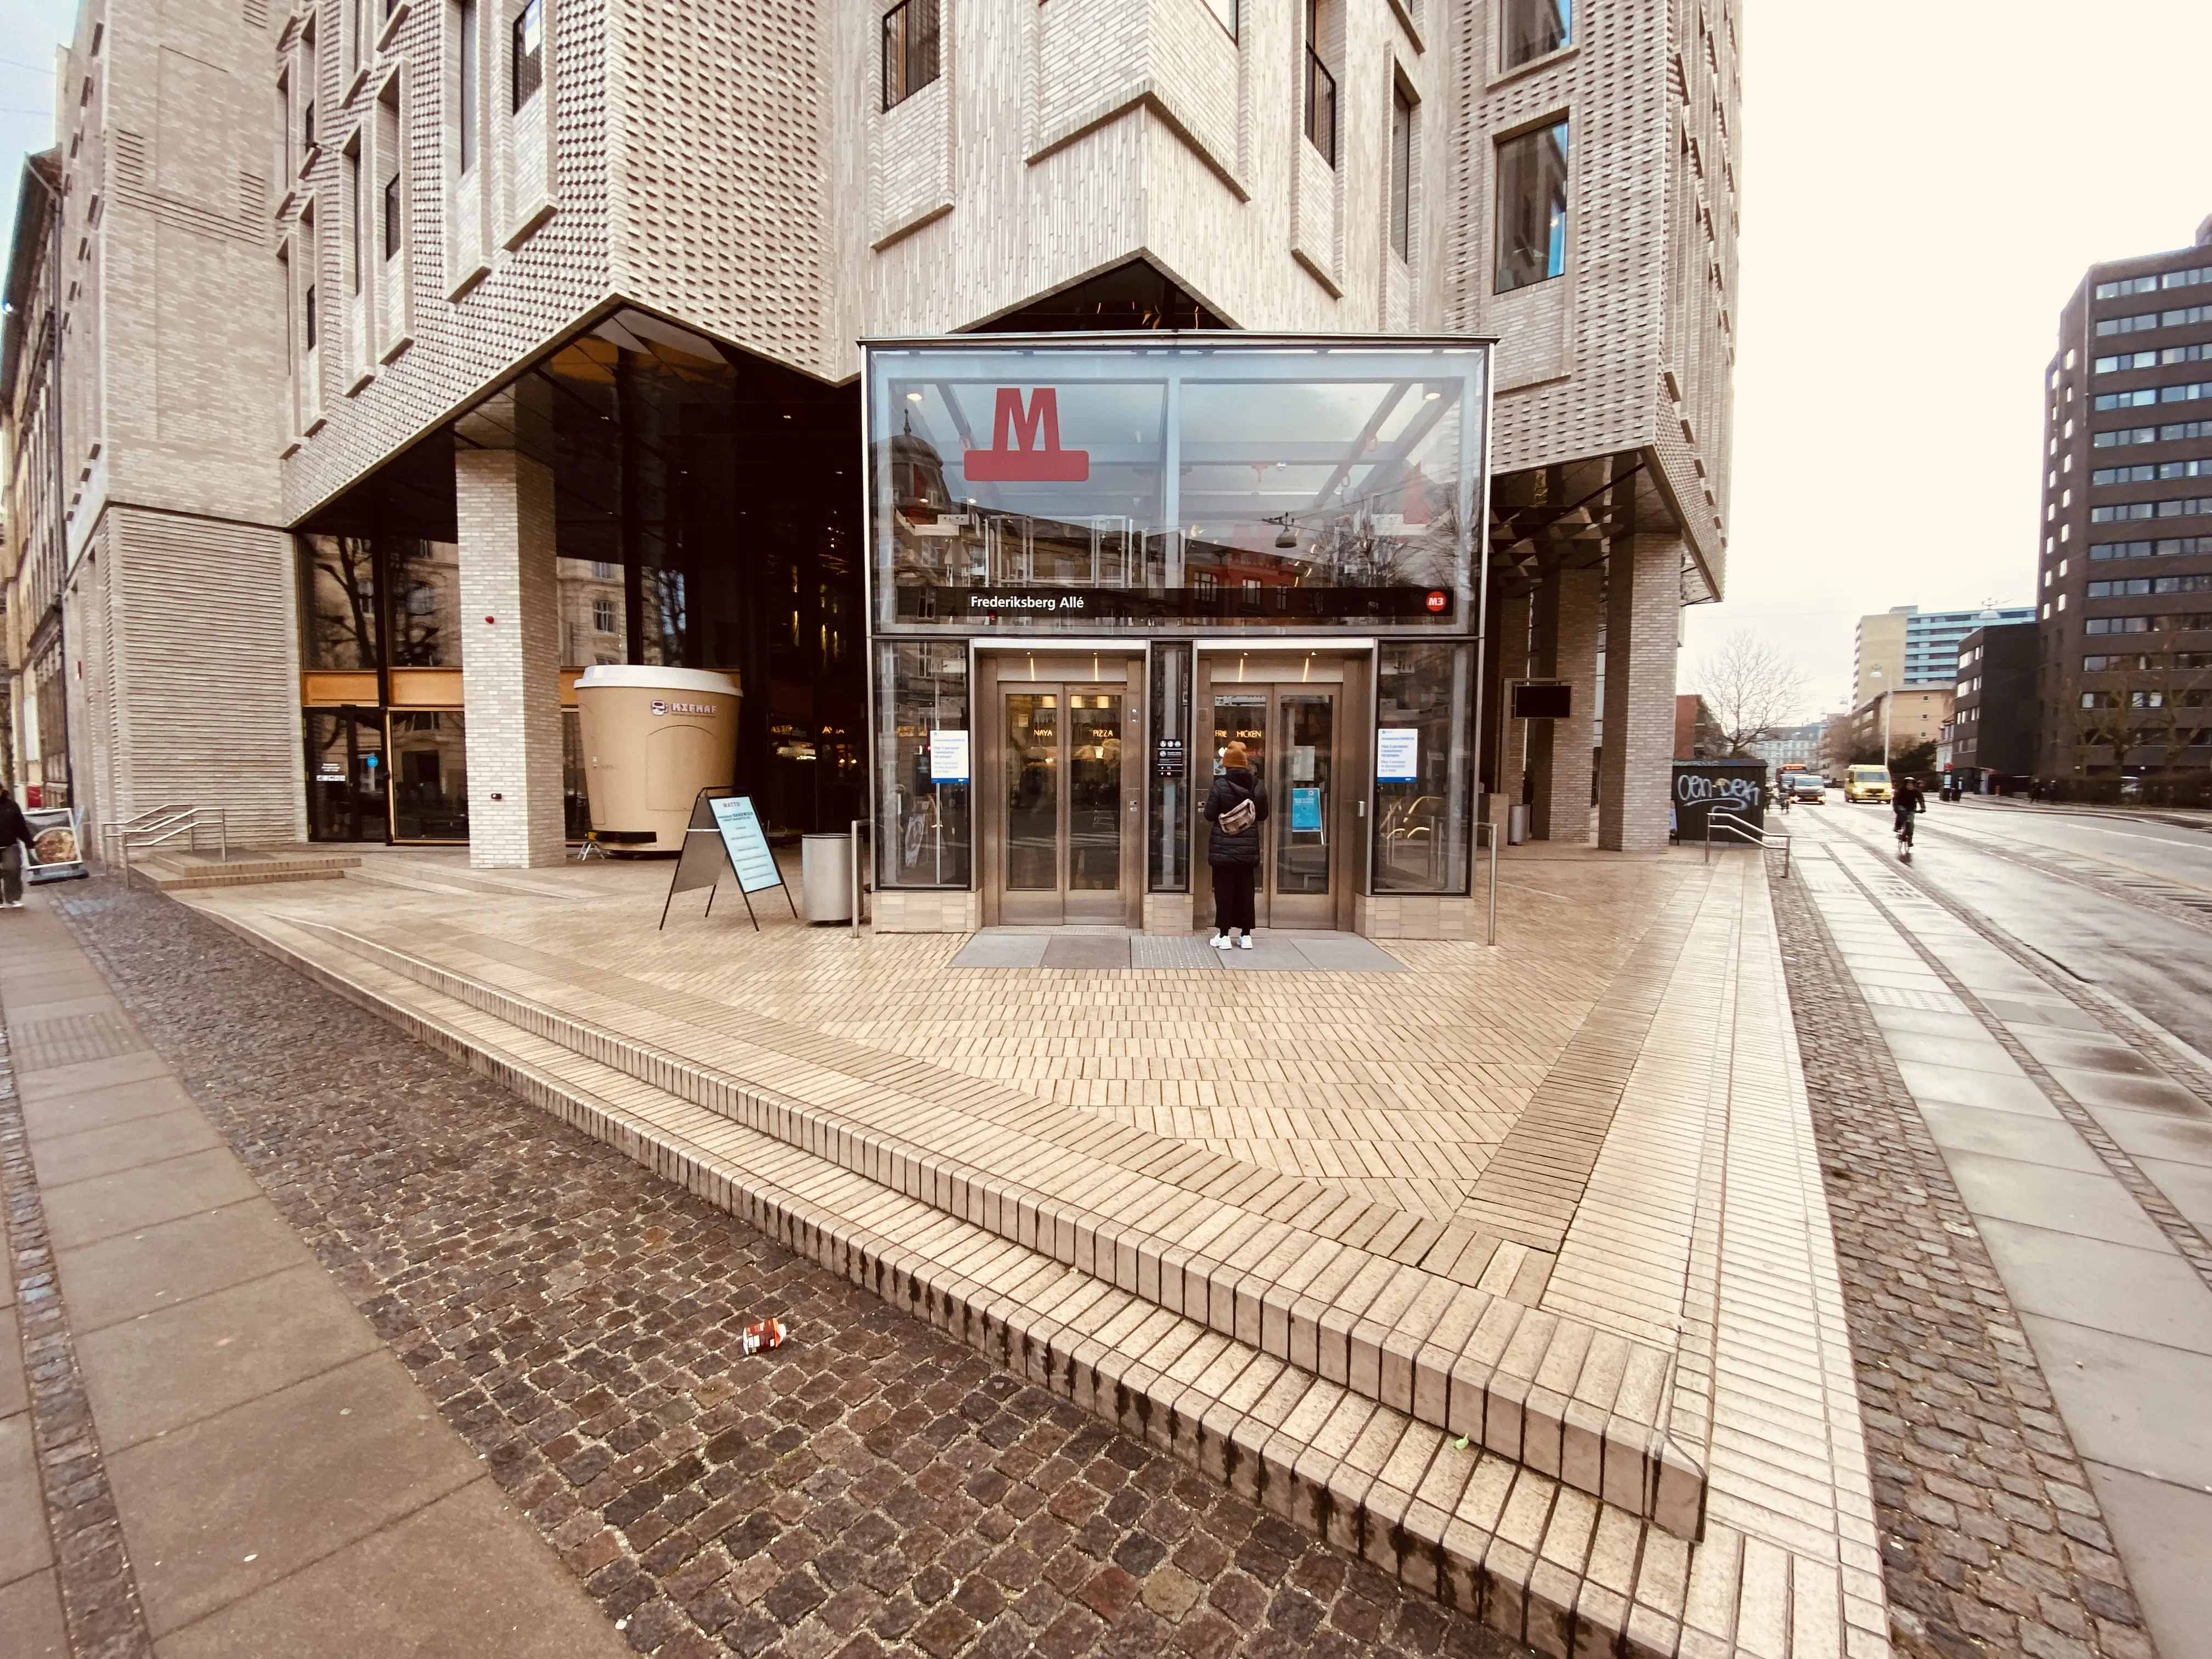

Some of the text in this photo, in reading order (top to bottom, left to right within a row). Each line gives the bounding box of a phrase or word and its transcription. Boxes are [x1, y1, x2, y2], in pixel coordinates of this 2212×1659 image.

[992, 387, 1060, 451] M
[970, 596, 1084, 611] Frederiksberg Allé
[1428, 597, 1443, 606] M3
